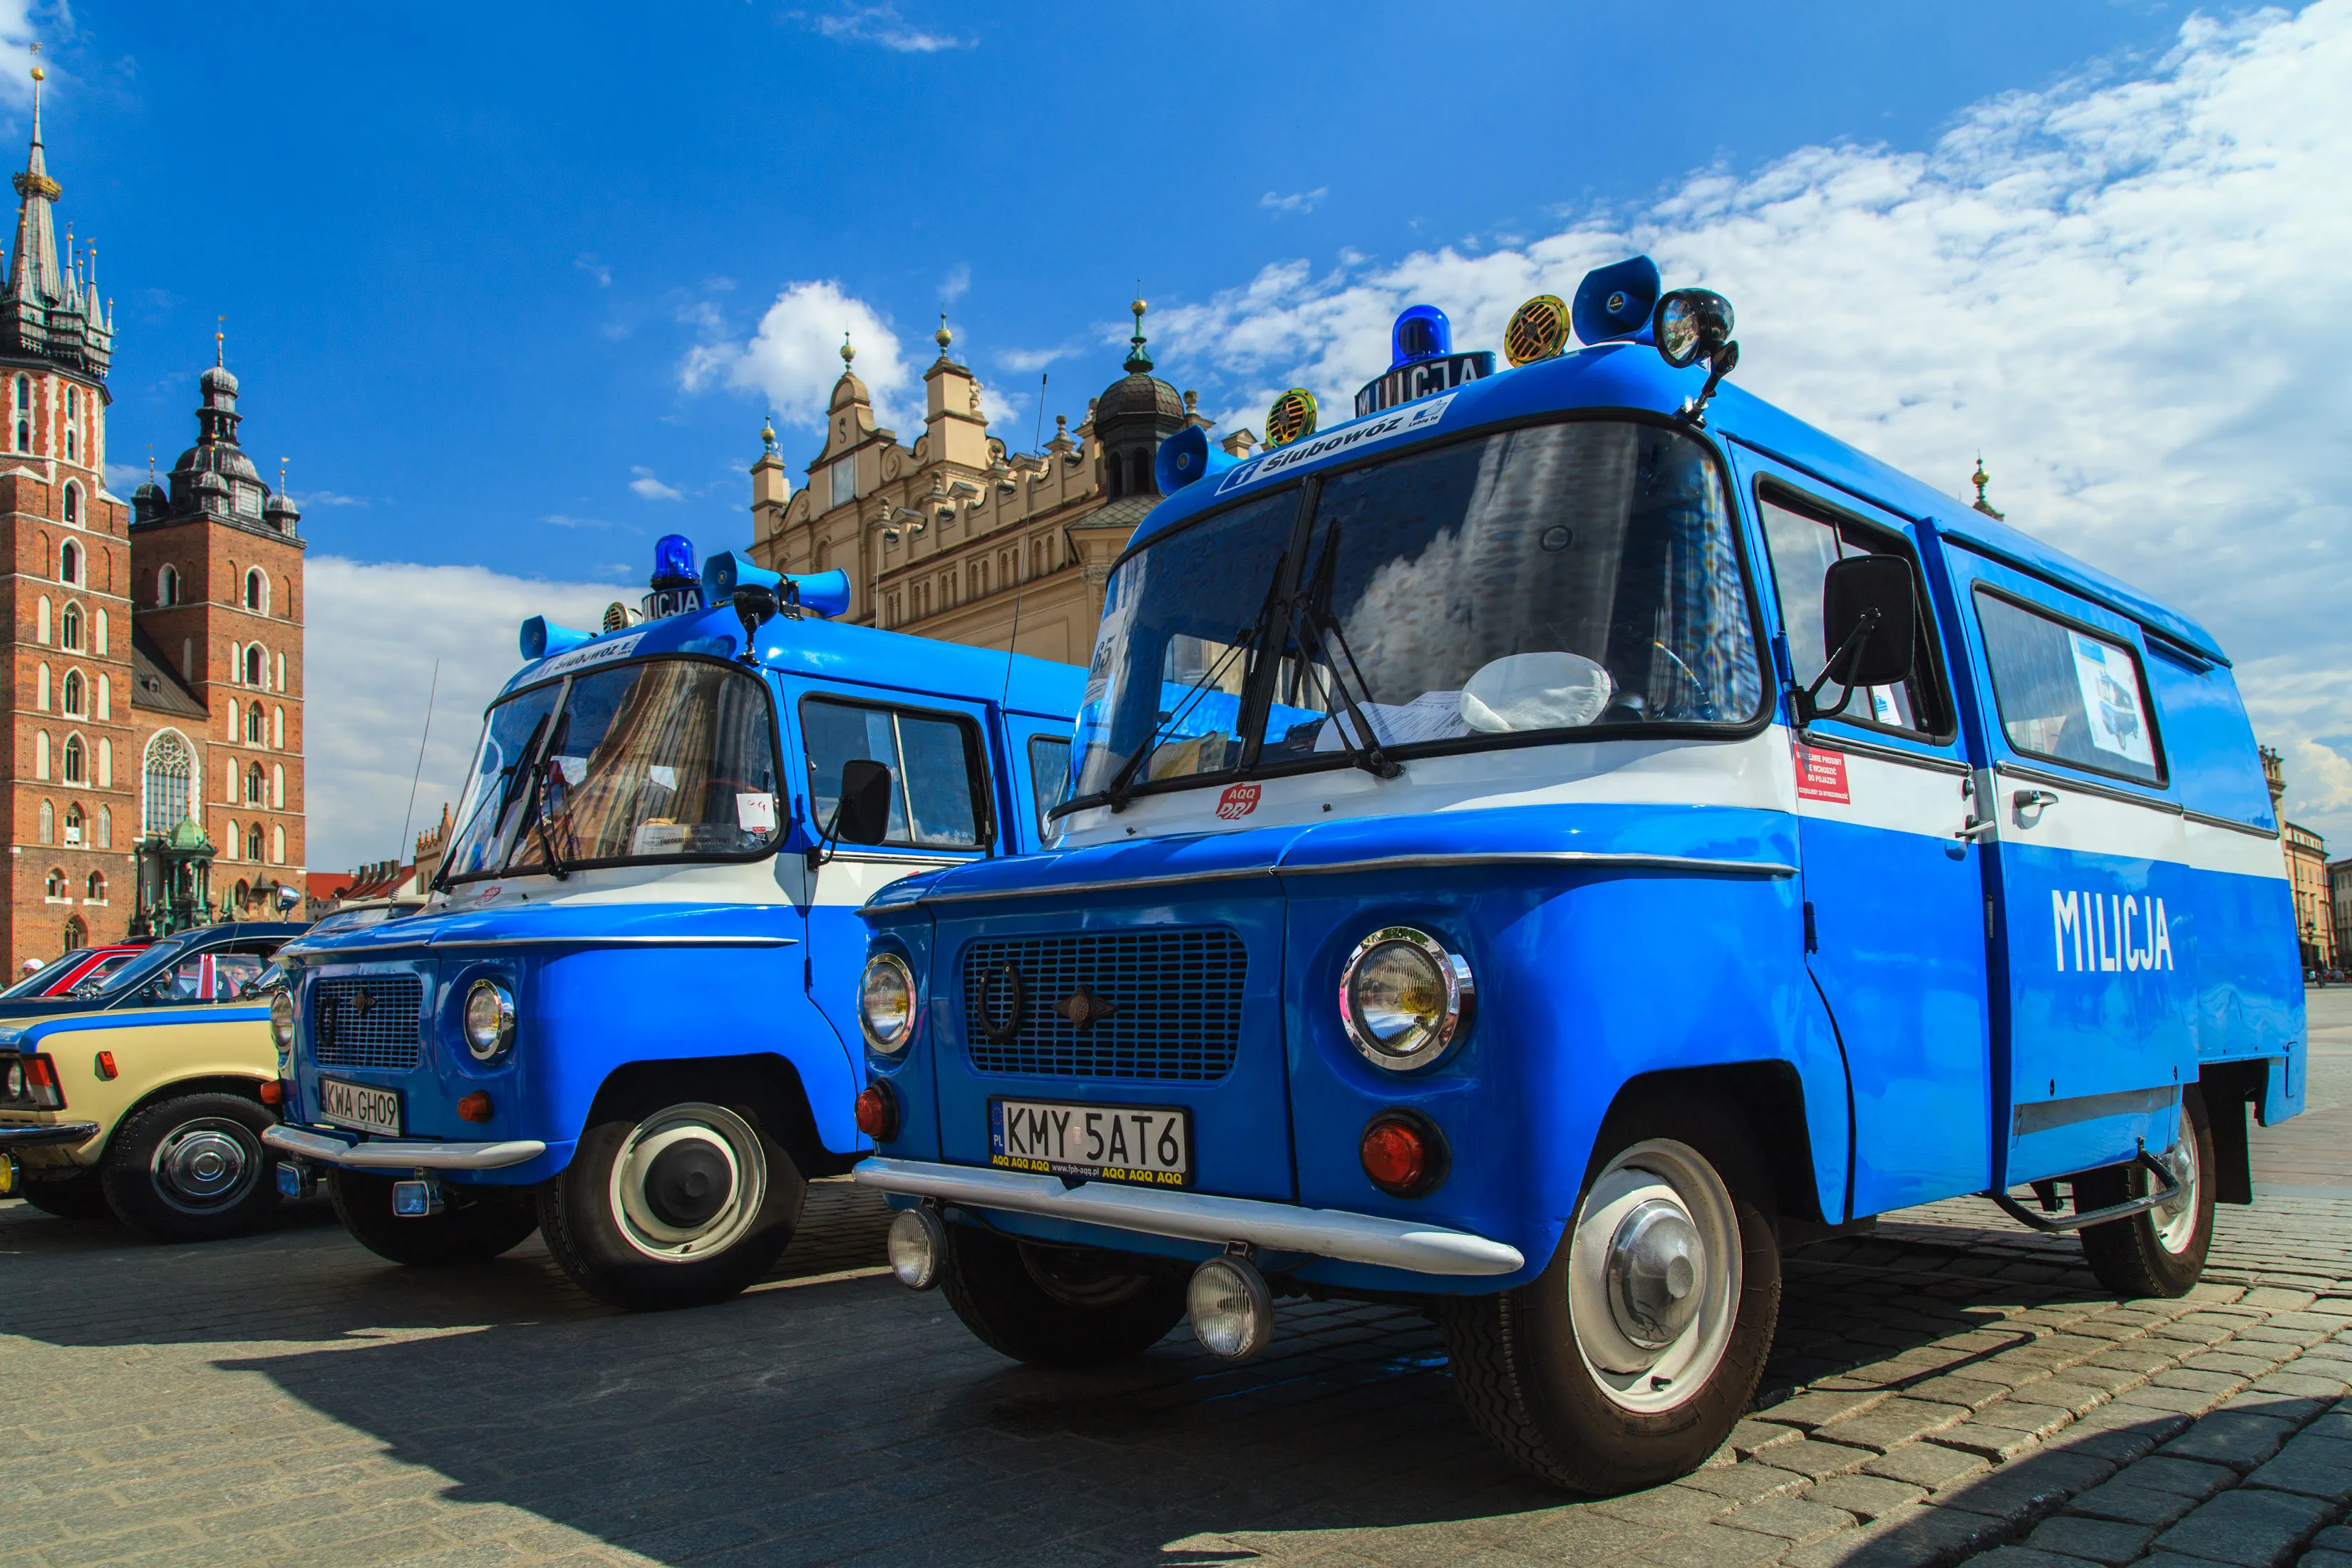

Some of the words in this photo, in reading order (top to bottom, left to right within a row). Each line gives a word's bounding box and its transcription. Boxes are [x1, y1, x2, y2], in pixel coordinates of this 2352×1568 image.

[1262, 416, 1404, 473] Ślubowóz
[1822, 755, 1842, 765] PROSIMY
[1815, 775, 1836, 785] POJAZDU
[1229, 788, 1255, 800] AQQ
[1216, 802, 1253, 819] PRL
[2051, 889, 2174, 972] MILICJA
[327, 1083, 354, 1118] KWA
[358, 1090, 396, 1125] GH09
[994, 1134, 1004, 1147] PL
[1007, 1107, 1071, 1158] KMY
[1085, 1113, 1179, 1167] 5AT6
[993, 1155, 1009, 1166] AQQ
[1011, 1157, 1028, 1169] AQQ
[1031, 1160, 1049, 1172] AQQ
[1052, 1164, 1099, 1176] www.fph-aqq.pl
[1102, 1167, 1125, 1180] AQQ
[1129, 1170, 1152, 1182] AQQ
[1157, 1172, 1182, 1185] AQQ
